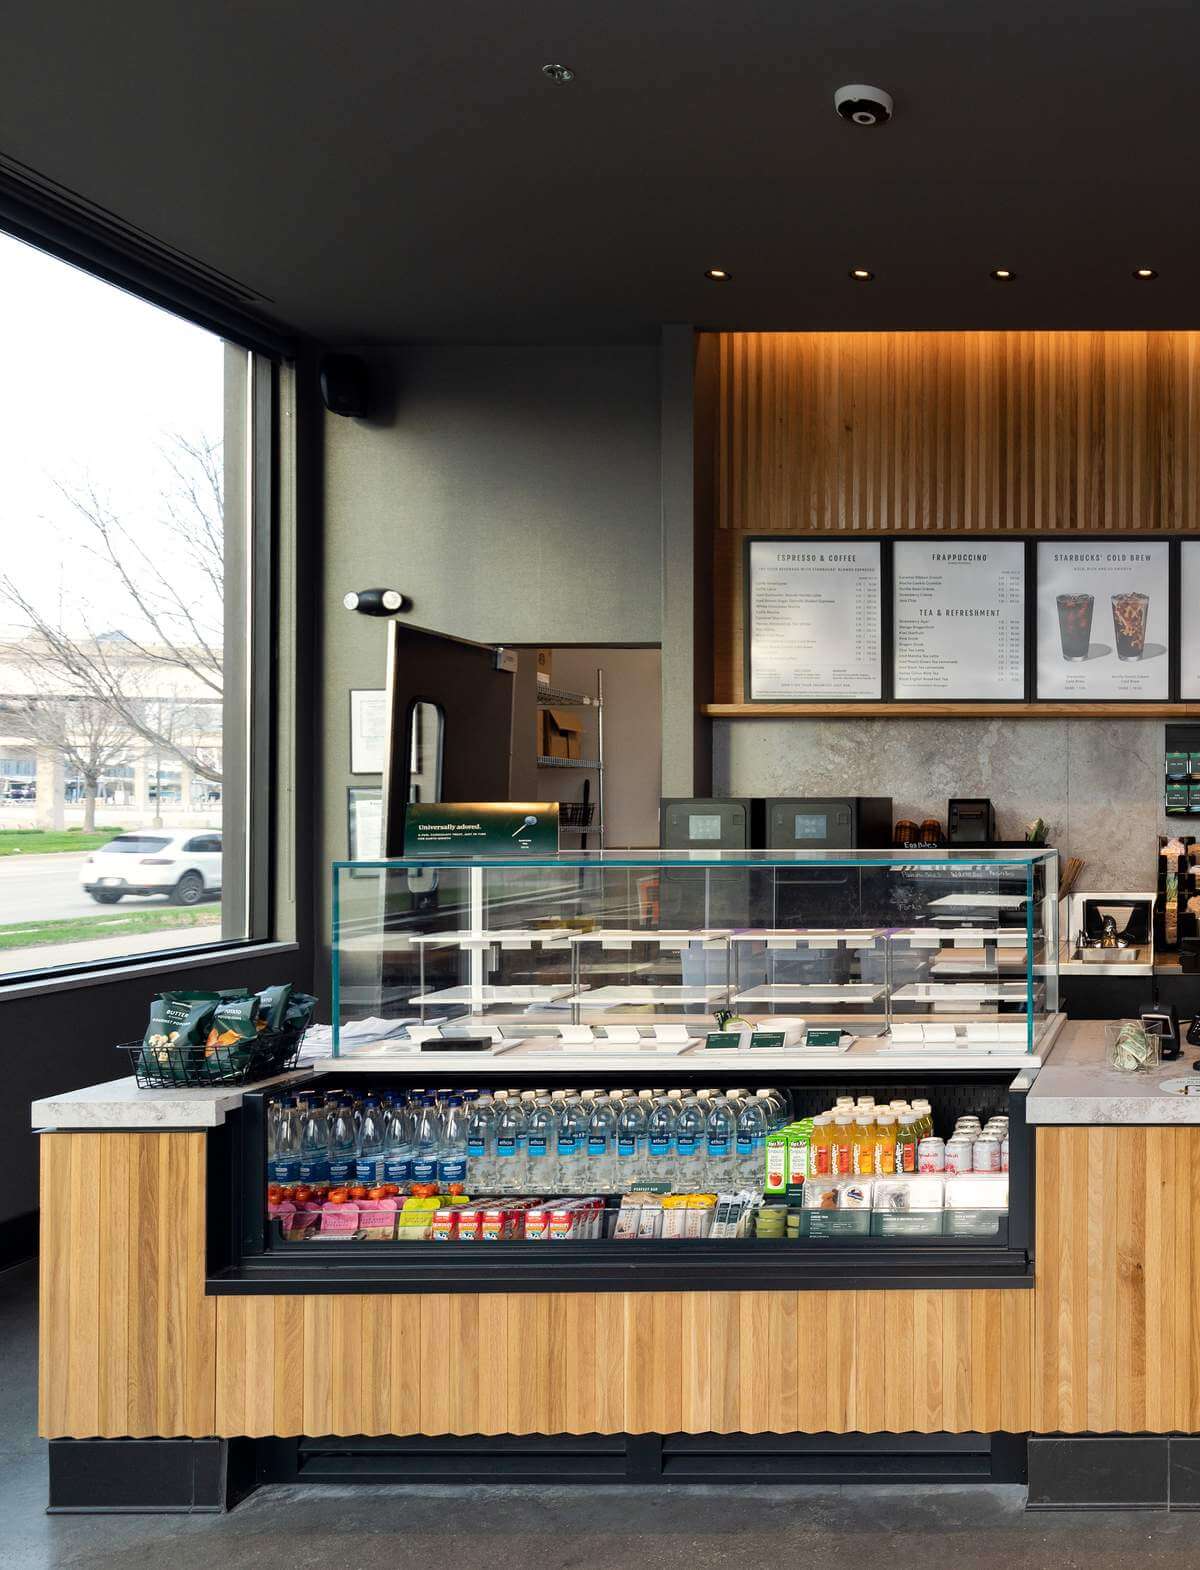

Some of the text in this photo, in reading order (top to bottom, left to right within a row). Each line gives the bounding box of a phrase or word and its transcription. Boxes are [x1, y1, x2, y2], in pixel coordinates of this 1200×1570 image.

[777, 554, 856, 562] ESPRESSO & COFFEE
[920, 609, 1000, 617] TEA & REFRESHMENT
[166, 1009, 189, 1018] BUTTER
